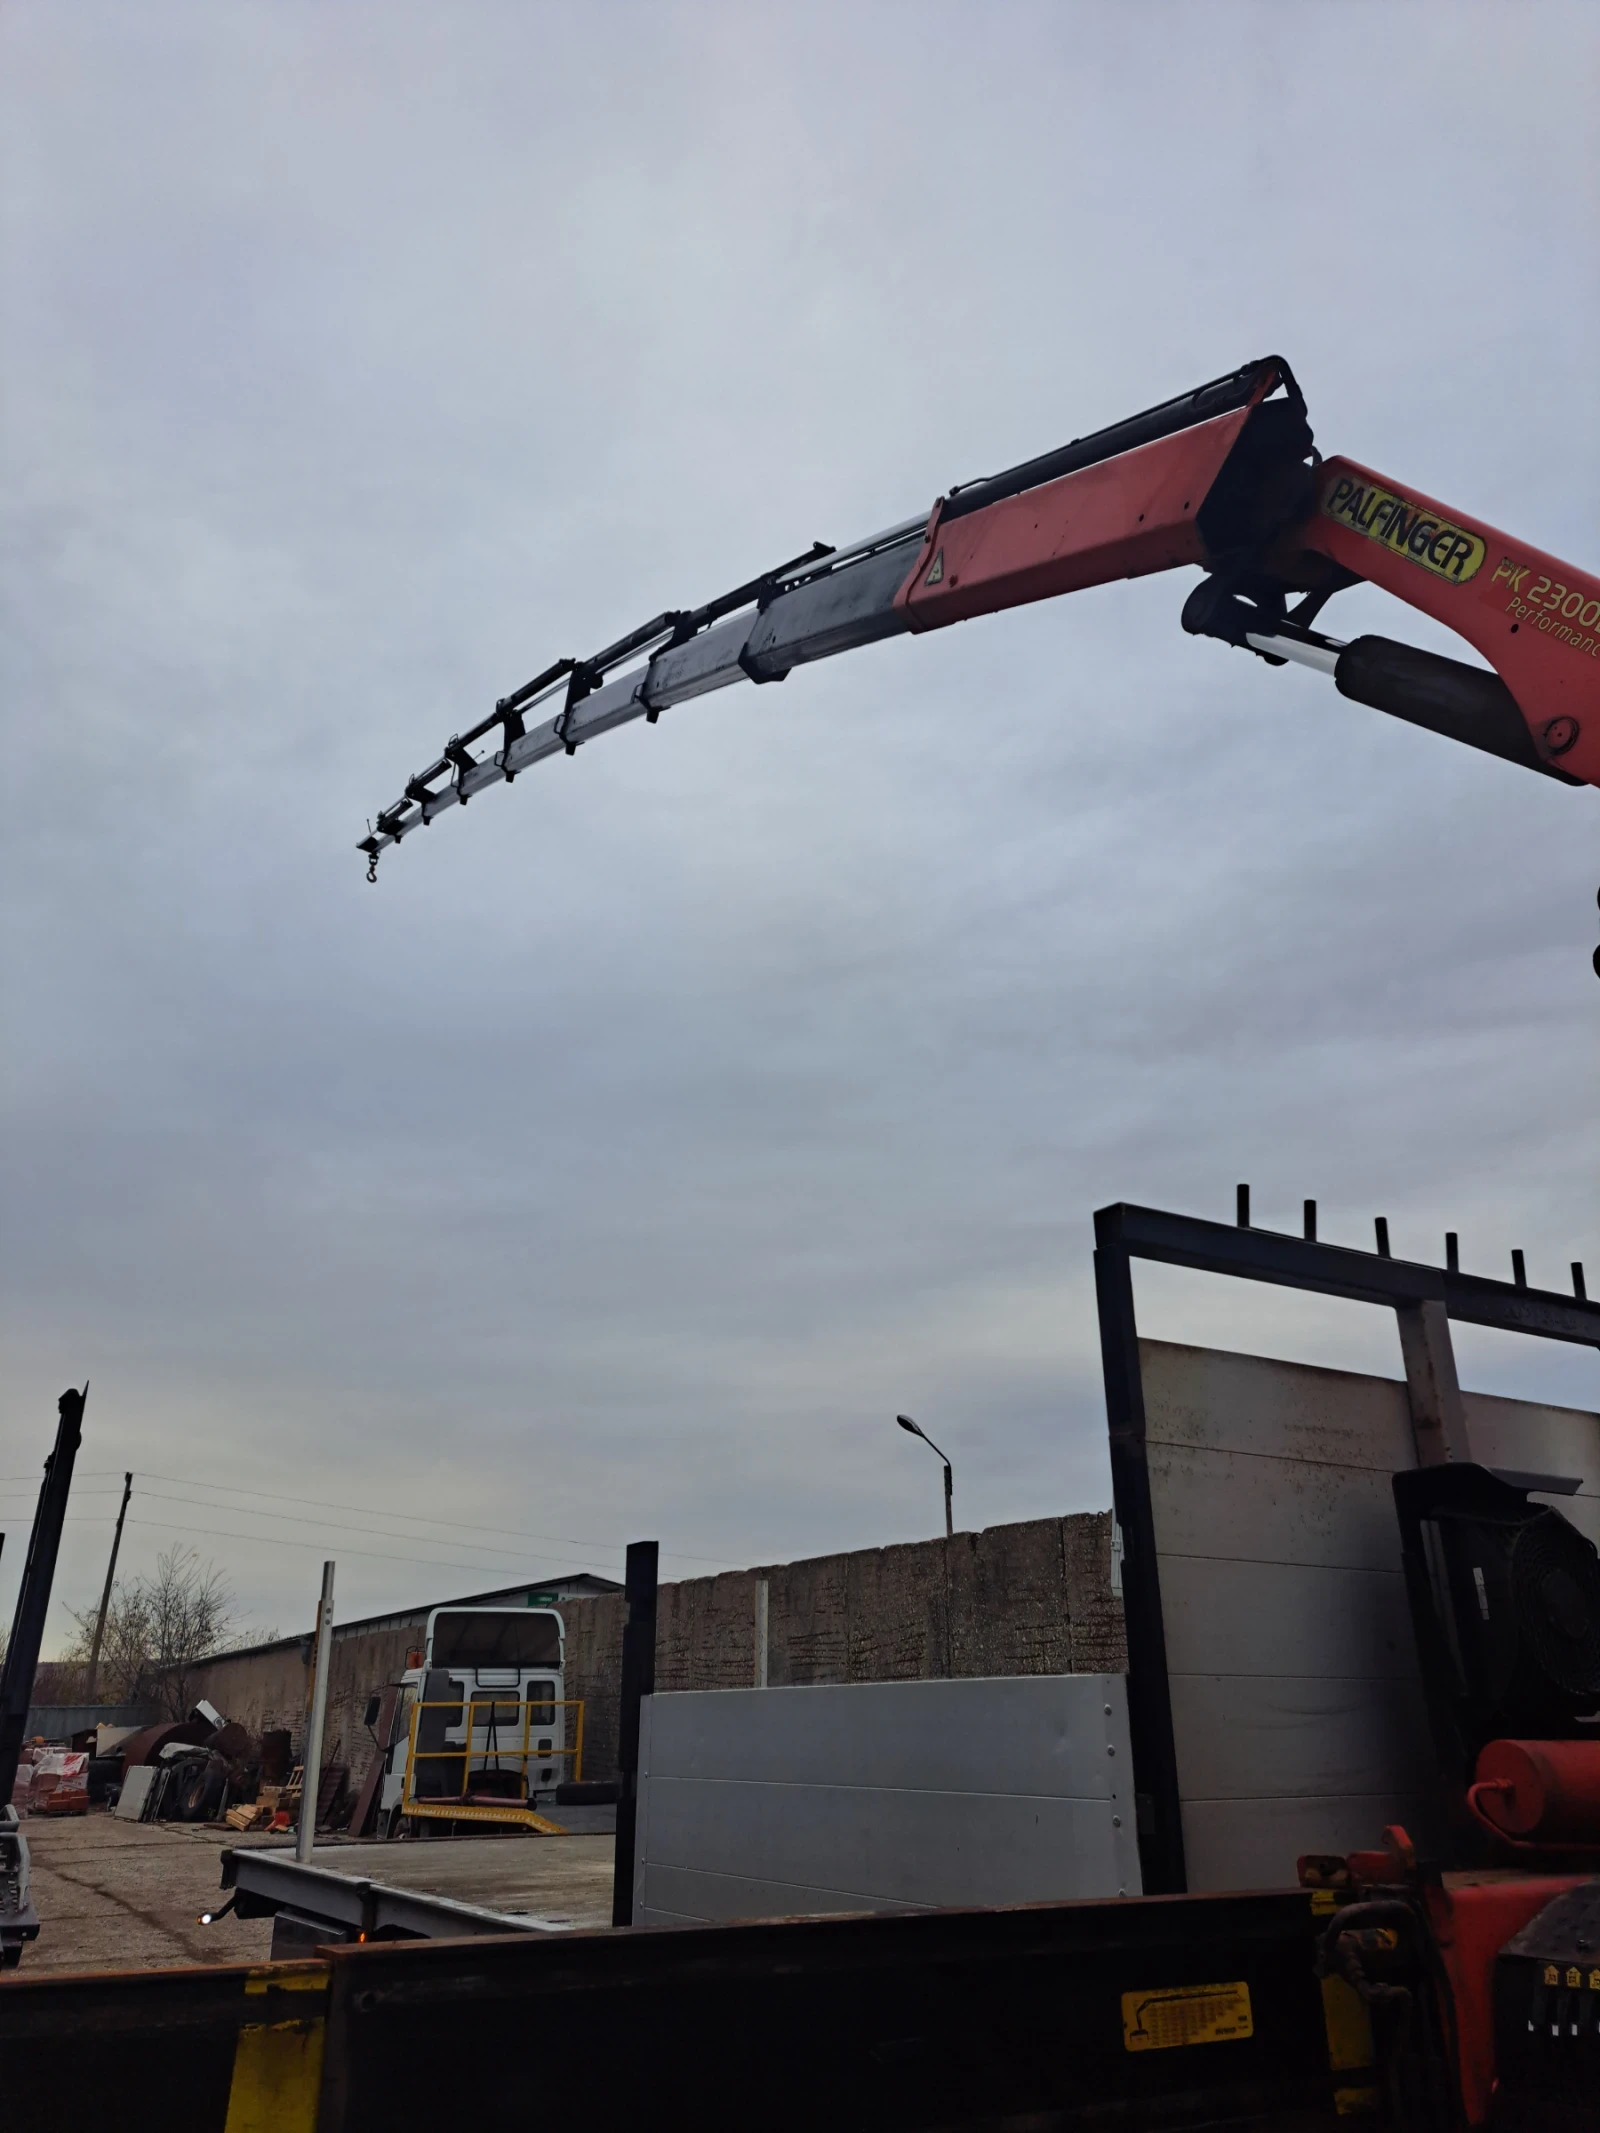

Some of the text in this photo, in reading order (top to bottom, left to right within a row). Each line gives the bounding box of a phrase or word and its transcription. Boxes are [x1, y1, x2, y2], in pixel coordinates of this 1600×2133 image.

[1327, 478, 1475, 576] PALFINGER
[1491, 561, 1600, 633] PK 2300
